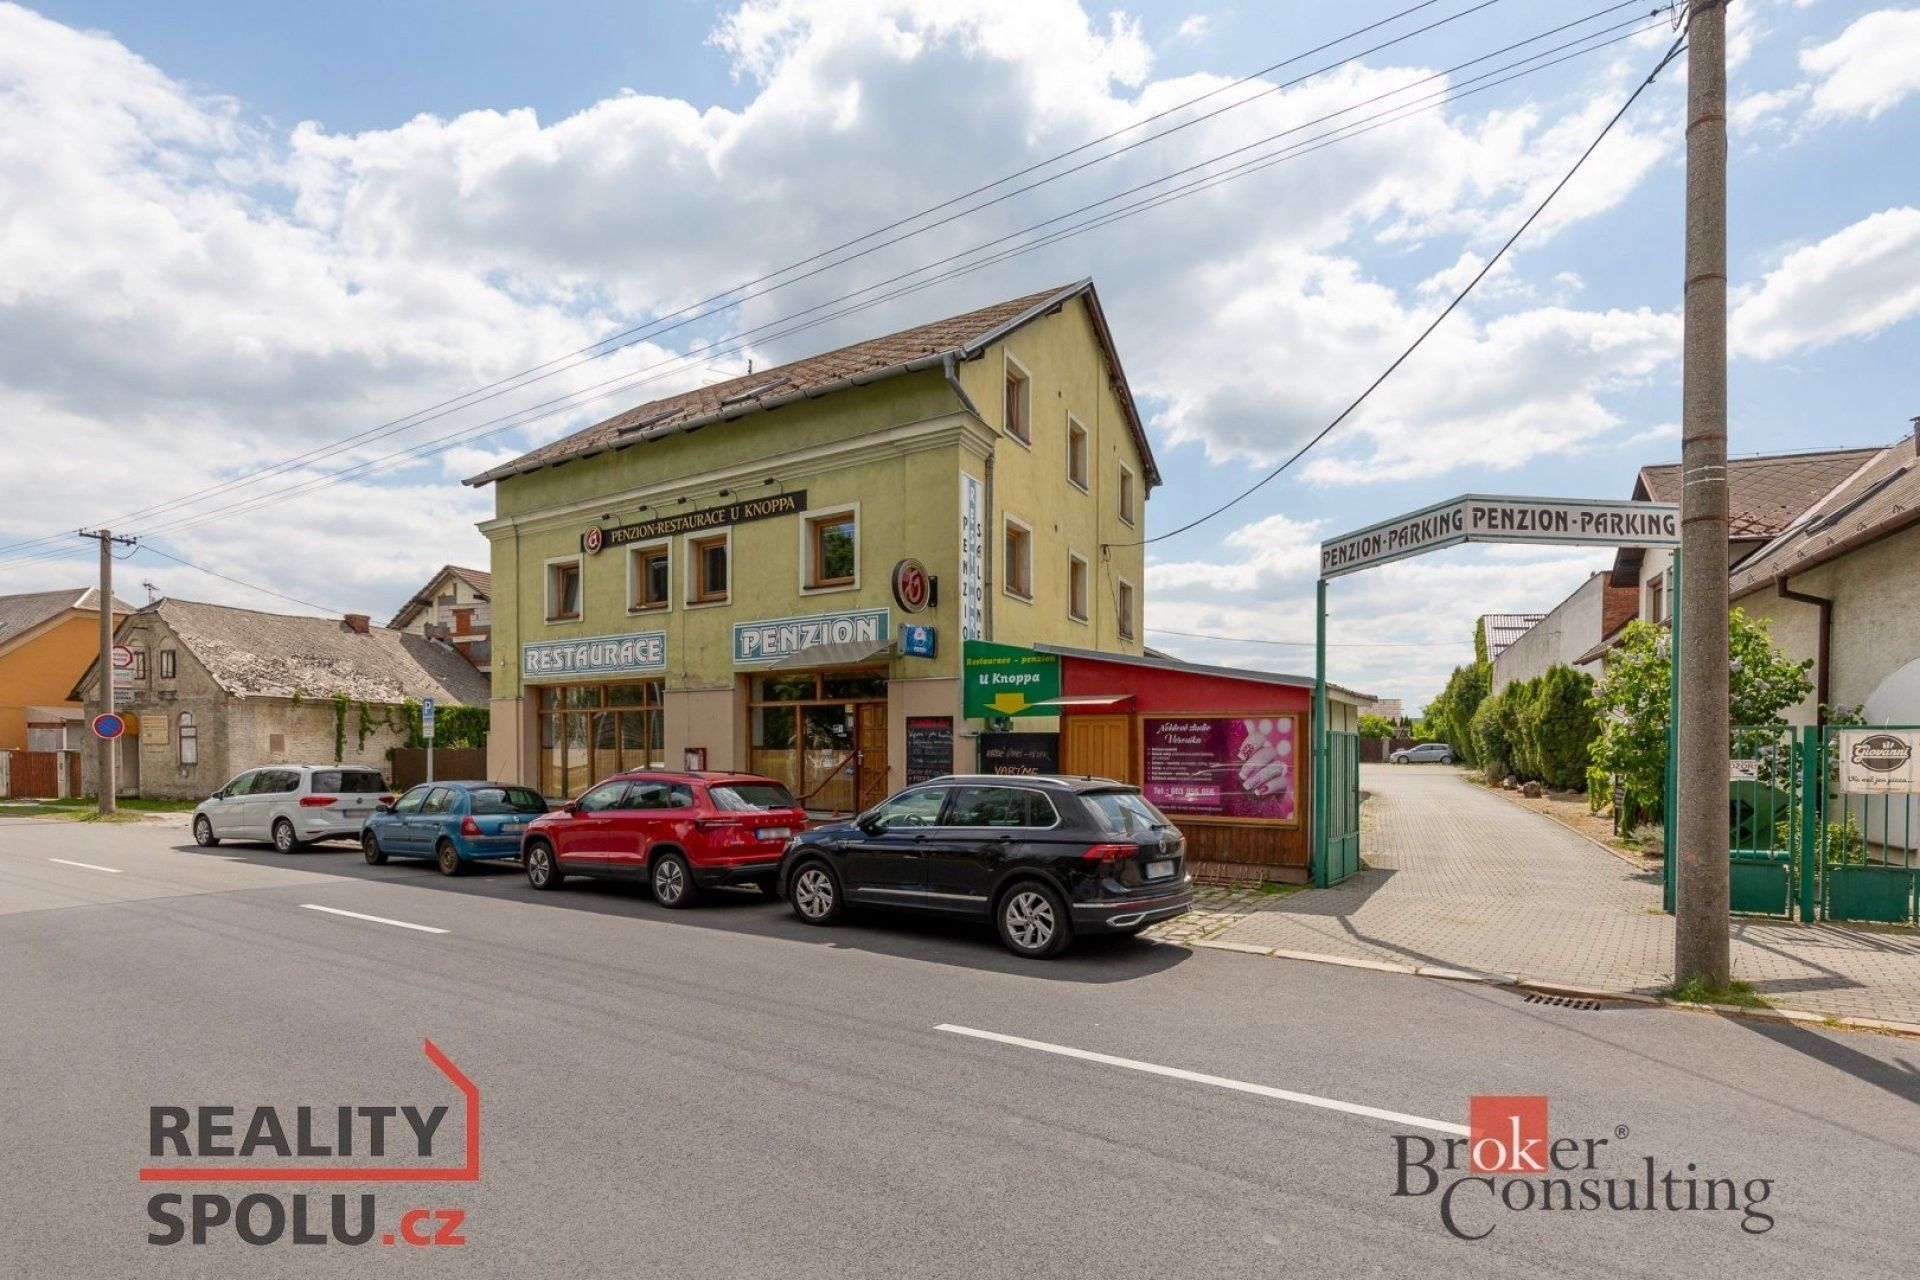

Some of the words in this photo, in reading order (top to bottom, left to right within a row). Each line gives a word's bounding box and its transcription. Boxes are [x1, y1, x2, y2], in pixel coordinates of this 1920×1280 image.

[611, 509, 726, 543] PENZION-RESTAURACE
[730, 506, 740, 521] U
[744, 496, 796, 518] KNOPPA
[1471, 506, 1677, 536] PENZION-PARKING
[1322, 508, 1463, 569] PENZION-PARKING
[741, 616, 879, 658] PENZION
[525, 637, 663, 674] RESTAURACE
[1021, 654, 1056, 665] penzion
[979, 673, 990, 685] U
[992, 672, 1040, 686] Knoppa
[424, 701, 431, 715] P
[1853, 743, 1910, 762] Giovanni
